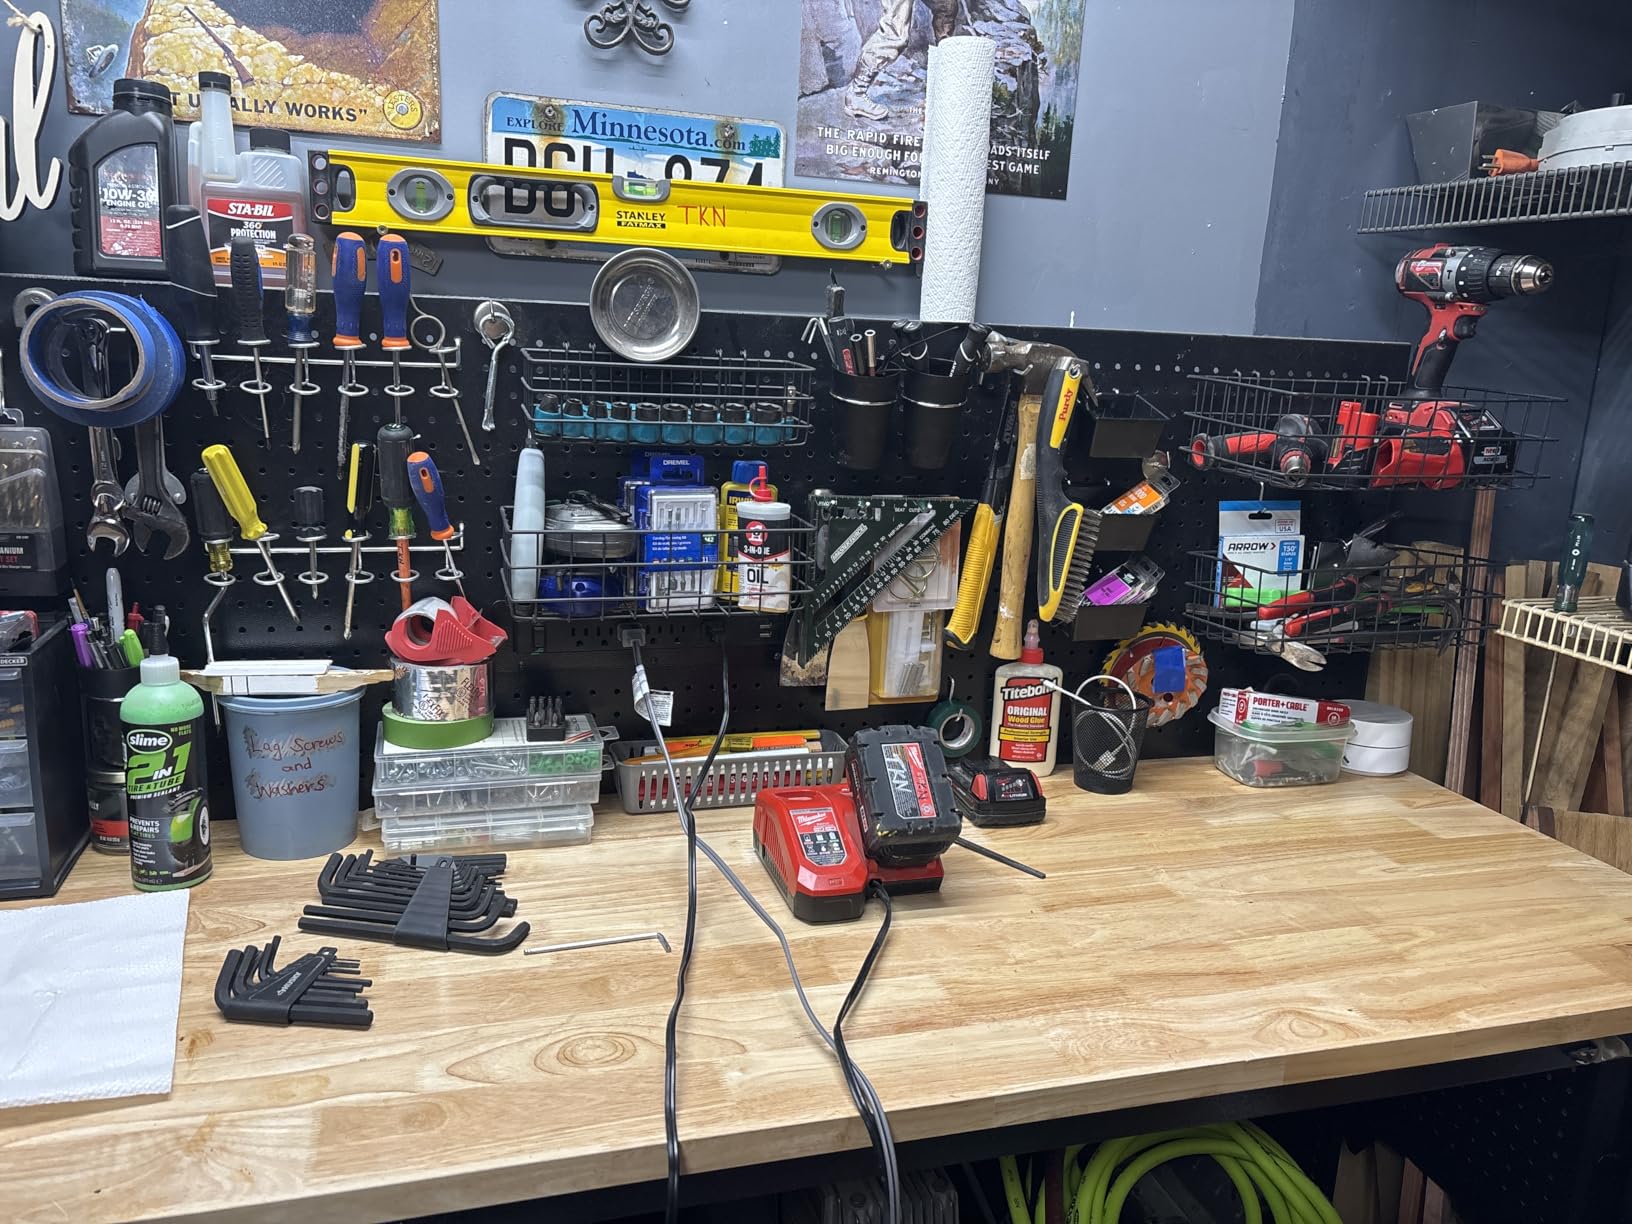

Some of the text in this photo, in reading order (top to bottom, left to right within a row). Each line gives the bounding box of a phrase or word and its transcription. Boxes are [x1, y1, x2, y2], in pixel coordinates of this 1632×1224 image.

[188, 92, 276, 114] UALLY
[507, 116, 564, 132] EXPLORE
[817, 127, 920, 147] THE RAPID FIRE
[826, 144, 922, 163] BIG ENOUGH FO
[990, 147, 1050, 161] ADS ITSELF
[1008, 161, 1040, 175] GAME
[616, 210, 666, 222] STANLEY
[677, 205, 726, 228] TKN
[230, 228, 276, 239] PROTECTION
[1059, 388, 1073, 421] Purdy
[1228, 542, 1269, 551] ARROW
[746, 568, 769, 584] OIL
[1002, 682, 1057, 700] Titebon
[1007, 706, 1047, 716] ORIGINAL
[1252, 696, 1310, 712] PORTER+CABLE
[1008, 716, 1029, 724] Wood
[130, 734, 168, 746] slime
[250, 731, 343, 760] Lag Screws
[128, 741, 192, 785] 2 IN 1
[282, 757, 312, 772] and
[128, 784, 144, 792] TIRE
[154, 776, 182, 787] TUBE
[153, 786, 181, 797] SEALANT
[253, 778, 325, 800] Washers
[130, 816, 160, 827] PREVENTS
